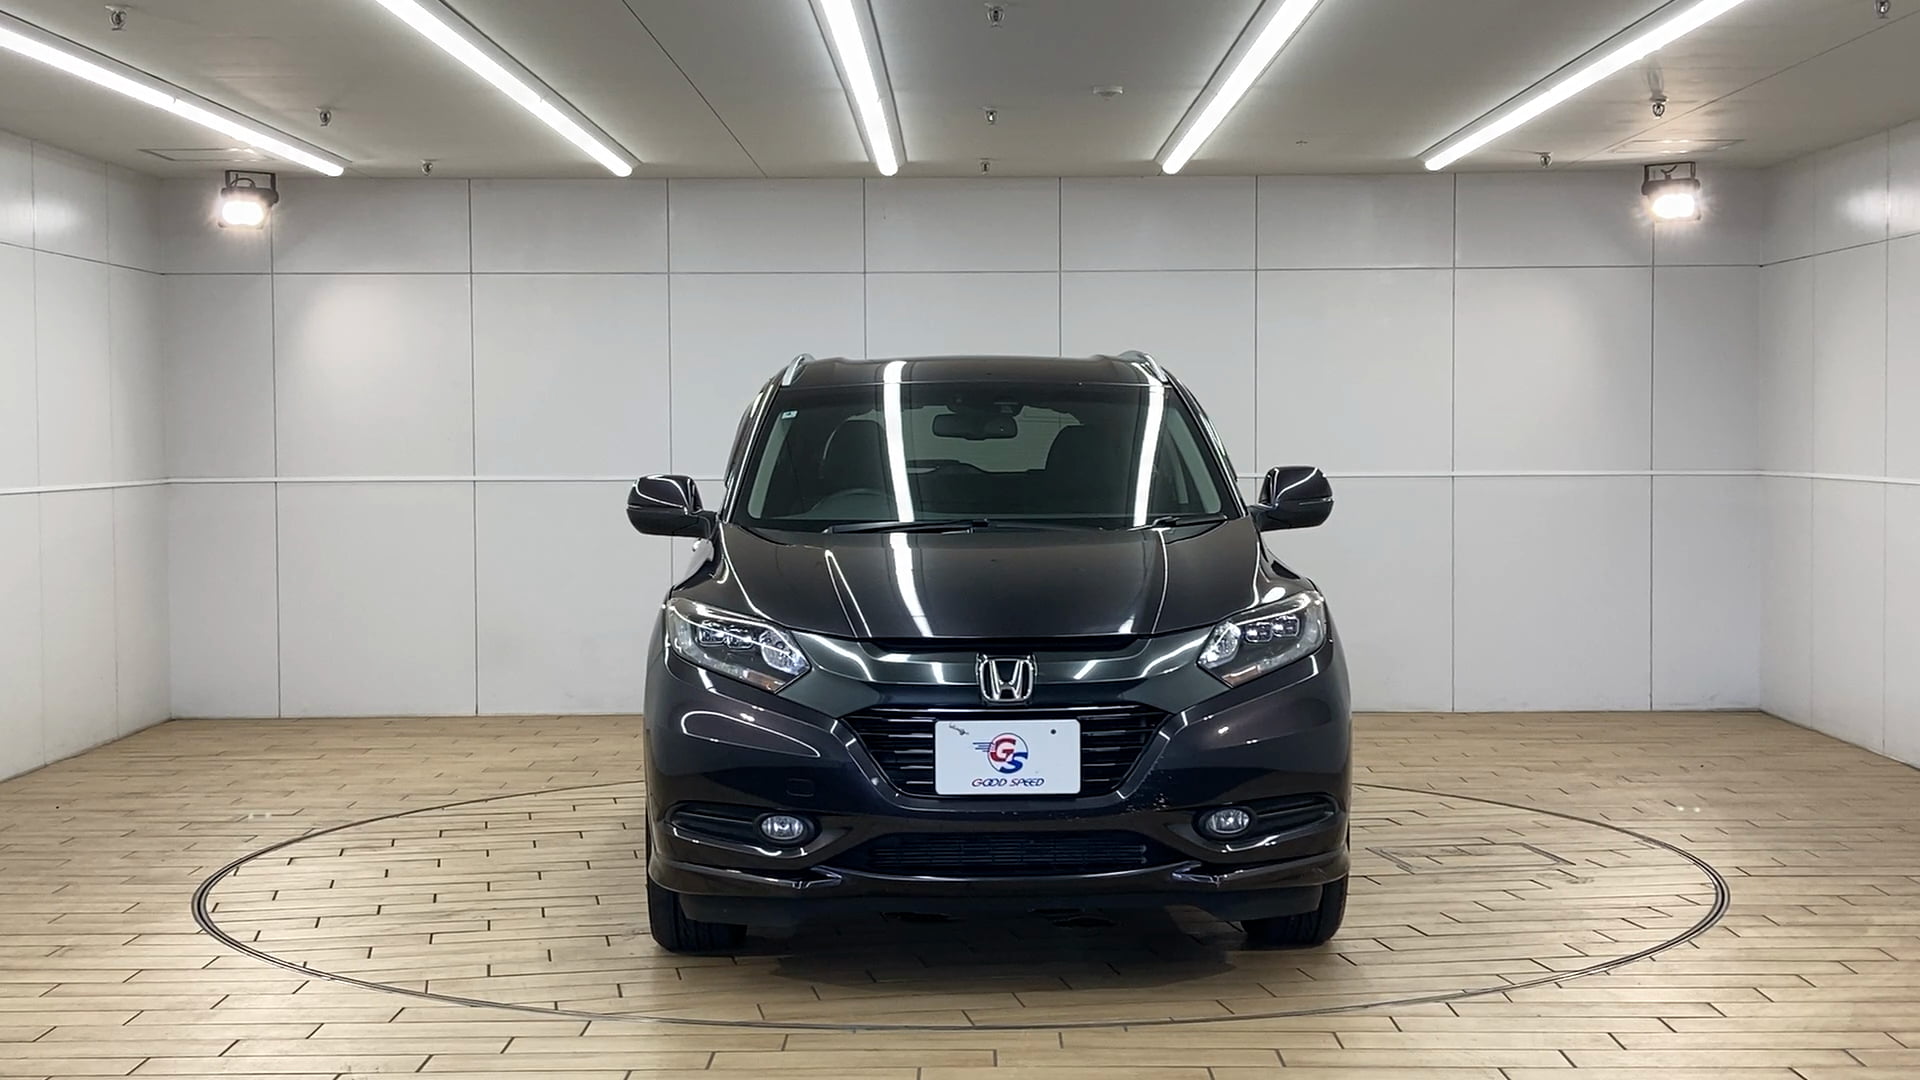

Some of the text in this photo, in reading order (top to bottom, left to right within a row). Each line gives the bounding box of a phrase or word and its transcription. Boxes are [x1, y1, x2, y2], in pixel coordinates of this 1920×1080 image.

[990, 738, 1028, 774] GS
[972, 778, 1044, 787] GOOD SPEED
